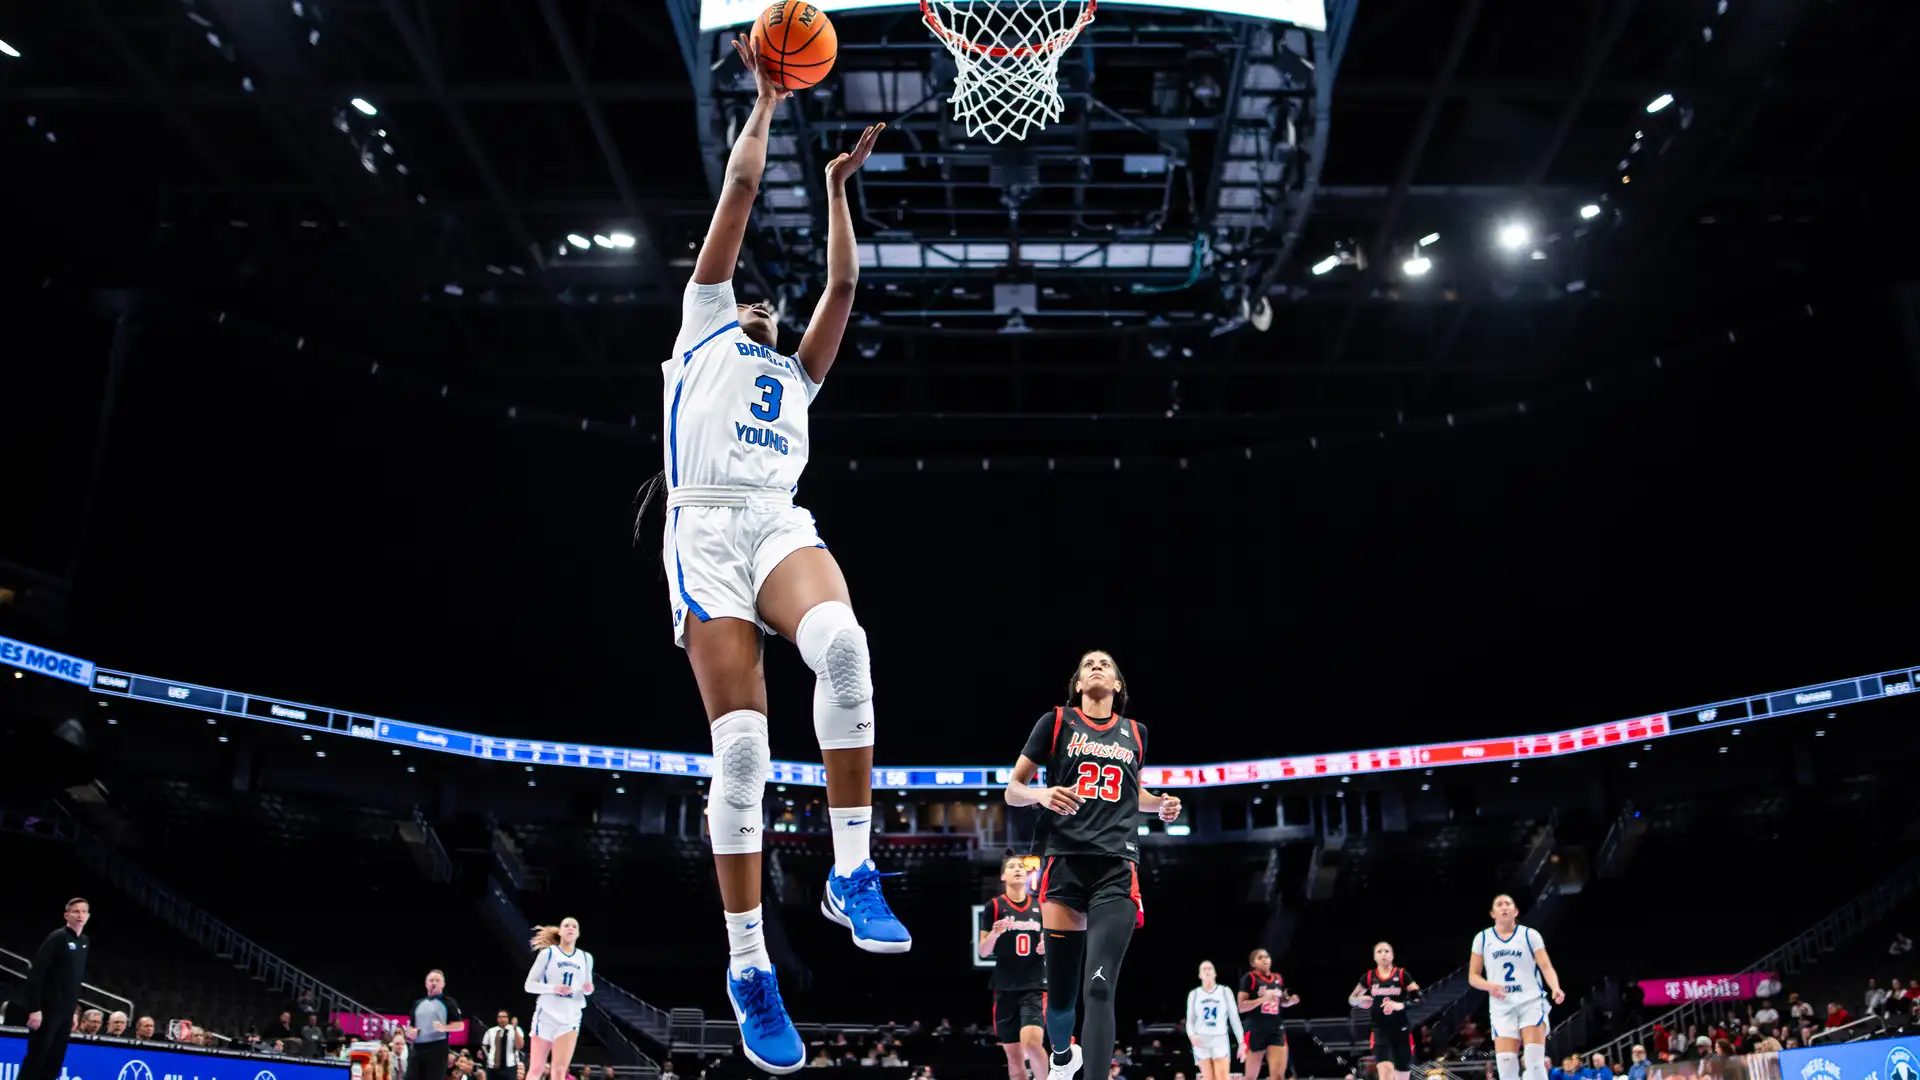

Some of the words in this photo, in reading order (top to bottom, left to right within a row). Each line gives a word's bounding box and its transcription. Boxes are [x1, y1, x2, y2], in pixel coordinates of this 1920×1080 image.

[750, 374, 784, 423] 3
[735, 421, 789, 456] YOUNG
[0, 641, 24, 662] ES
[26, 649, 83, 679] MORE
[1067, 732, 1135, 765] Houston
[1076, 761, 1124, 803] 23
[1016, 933, 1031, 957] 0
[563, 972, 574, 987] 11
[1503, 962, 1516, 981] 2
[1682, 978, 1741, 1000] Mobile
[1203, 1007, 1218, 1020] 24
